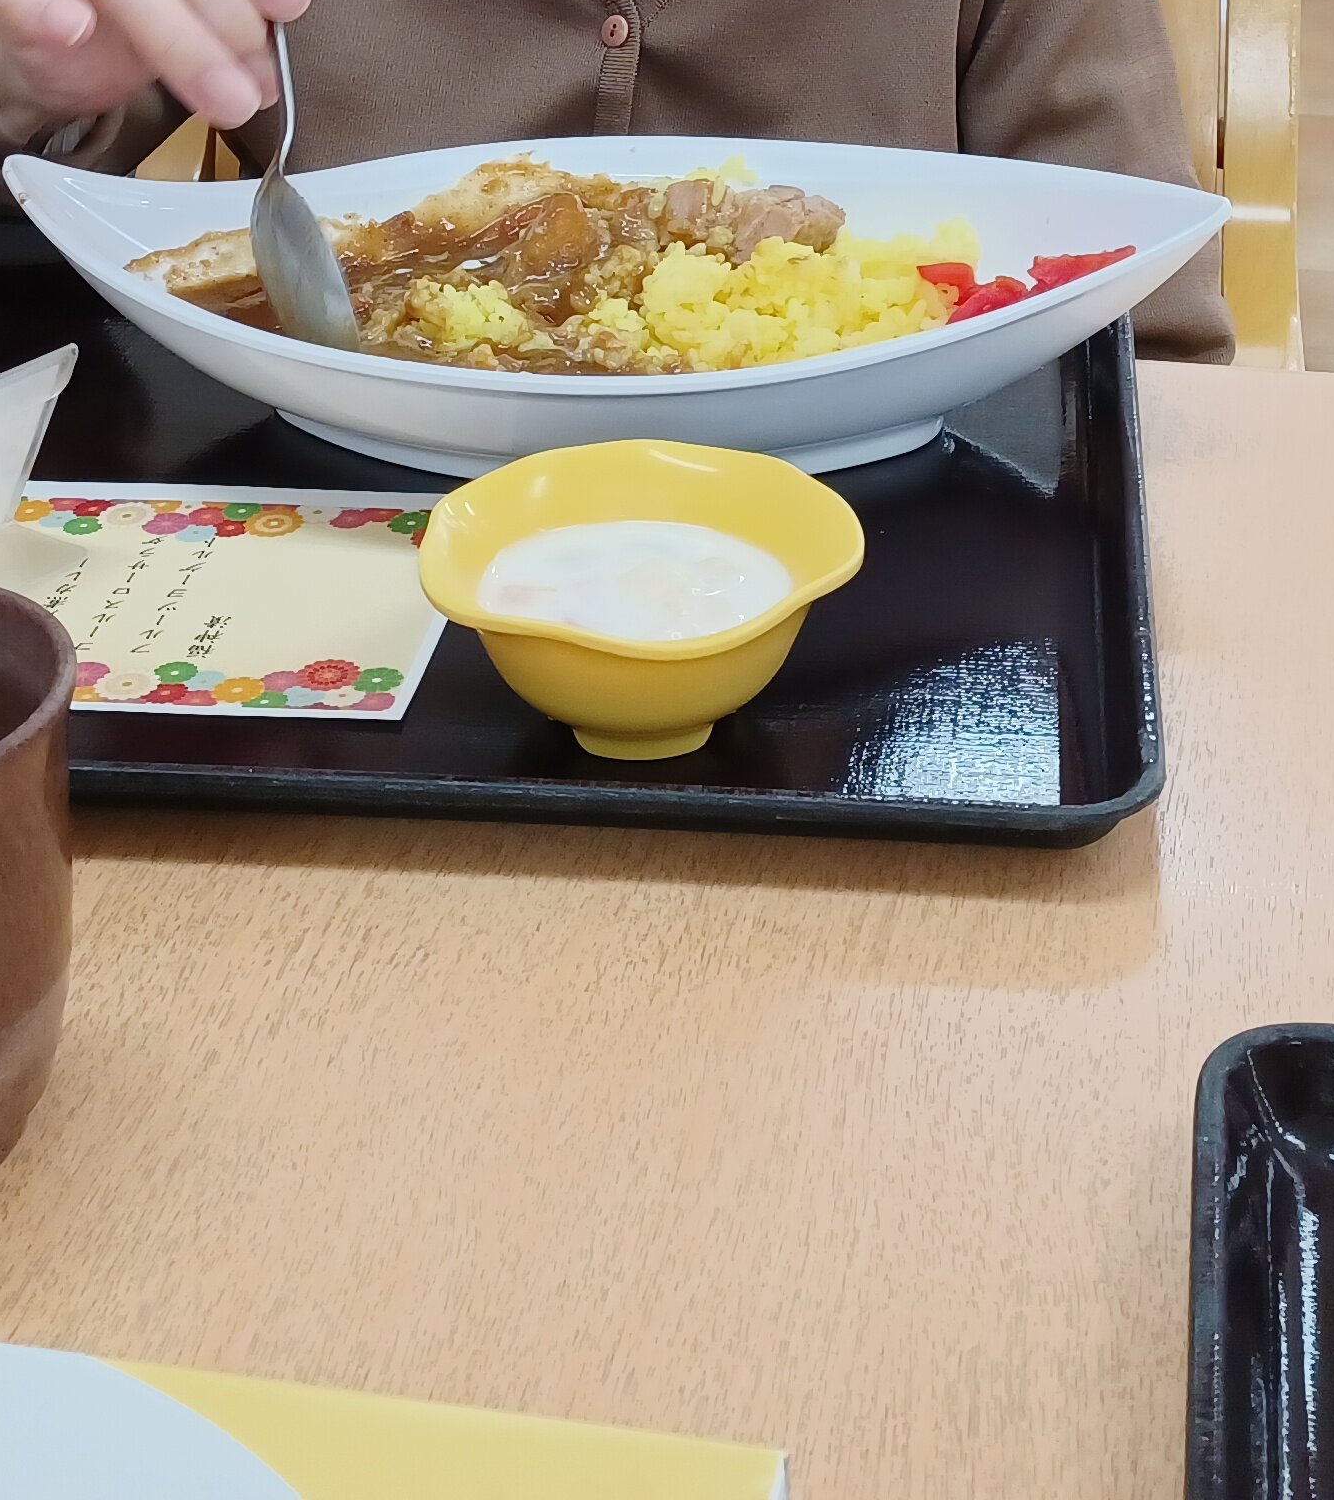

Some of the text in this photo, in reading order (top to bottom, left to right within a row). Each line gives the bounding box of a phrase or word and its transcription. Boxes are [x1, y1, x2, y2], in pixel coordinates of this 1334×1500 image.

[42, 557, 88, 616] 煮カレー
[75, 535, 167, 651] コールスローサラダ
[130, 537, 216, 653] フルーツヨーグルト
[186, 615, 232, 658] 福神漬
